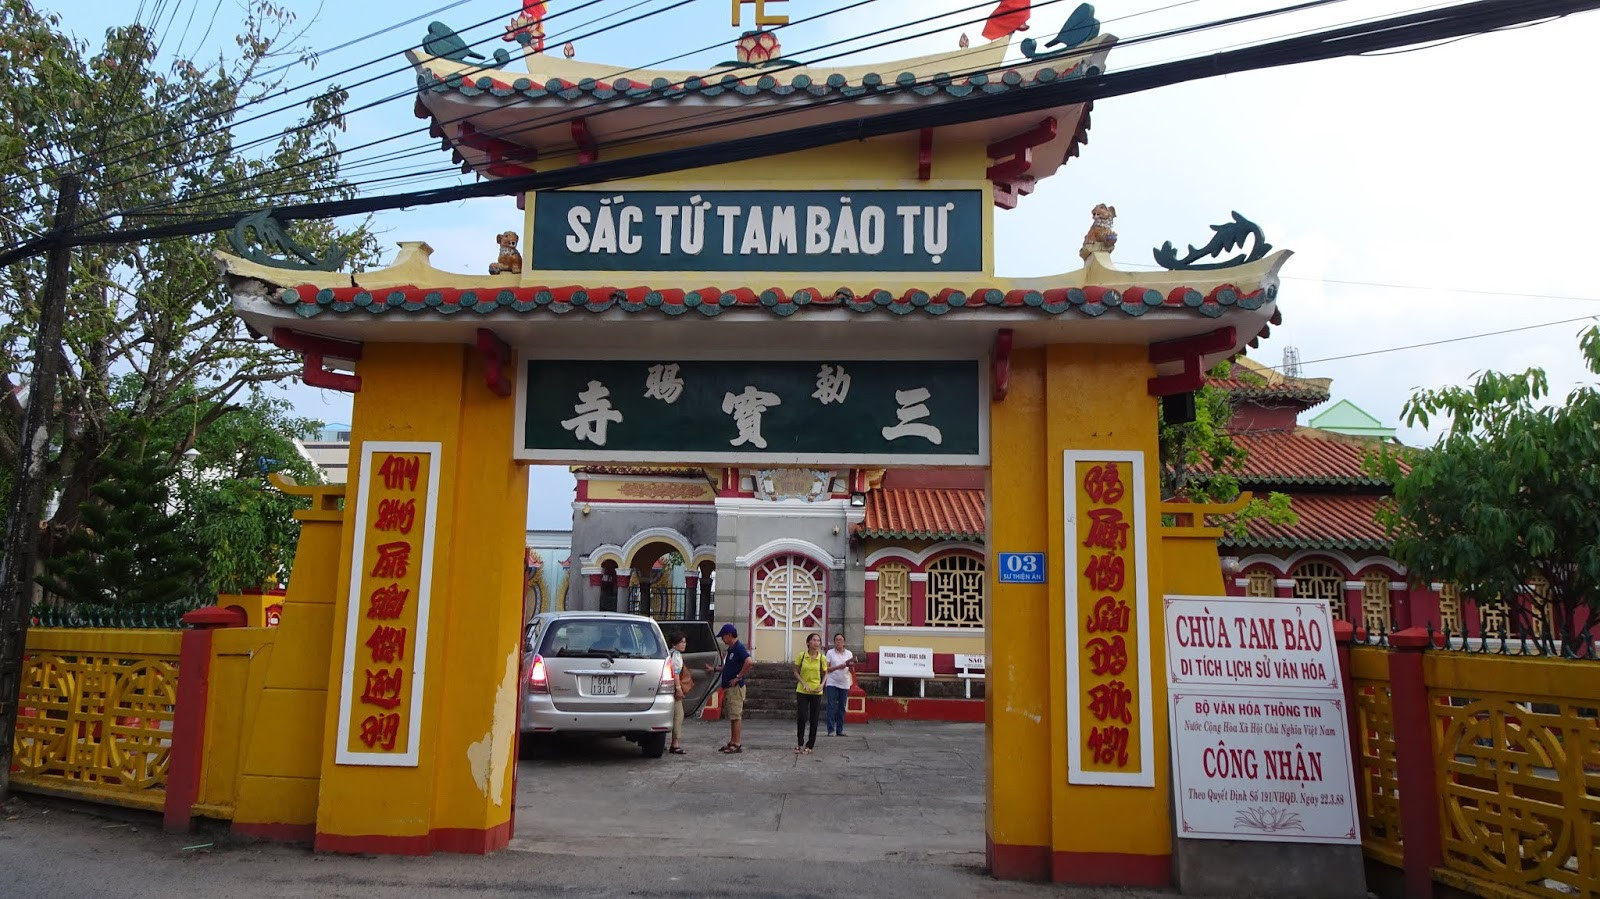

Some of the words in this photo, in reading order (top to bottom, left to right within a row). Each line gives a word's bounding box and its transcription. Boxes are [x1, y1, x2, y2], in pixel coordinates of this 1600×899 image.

[565, 195, 643, 254] SẮC
[655, 194, 712, 255] TỨ
[716, 206, 798, 255] TAM
[896, 202, 955, 264] TỰ
[1007, 555, 1037, 572] 03
[1176, 606, 1231, 648] CHÙA
[1234, 617, 1279, 650] TAM
[1281, 606, 1322, 652] BẢO
[1180, 658, 1192, 676] DI
[1195, 655, 1222, 677] TÍCH
[1225, 659, 1252, 681] LỊCH
[1255, 654, 1271, 678] SỬ
[1274, 658, 1298, 679] VĂN
[1301, 658, 1326, 680] HÓA
[593, 685, 616, 694] 131.04
[1195, 700, 1210, 716] BỘ
[1213, 701, 1235, 715] VĂN
[1239, 701, 1261, 716] HÓA
[1264, 702, 1300, 717] THÔNG
[1303, 705, 1322, 718] TIN
[1320, 726, 1336, 736] Nam
[1203, 740, 1258, 779] CÔNG
[1264, 742, 1323, 788] NHẬN
[1188, 788, 1205, 800] Theo
